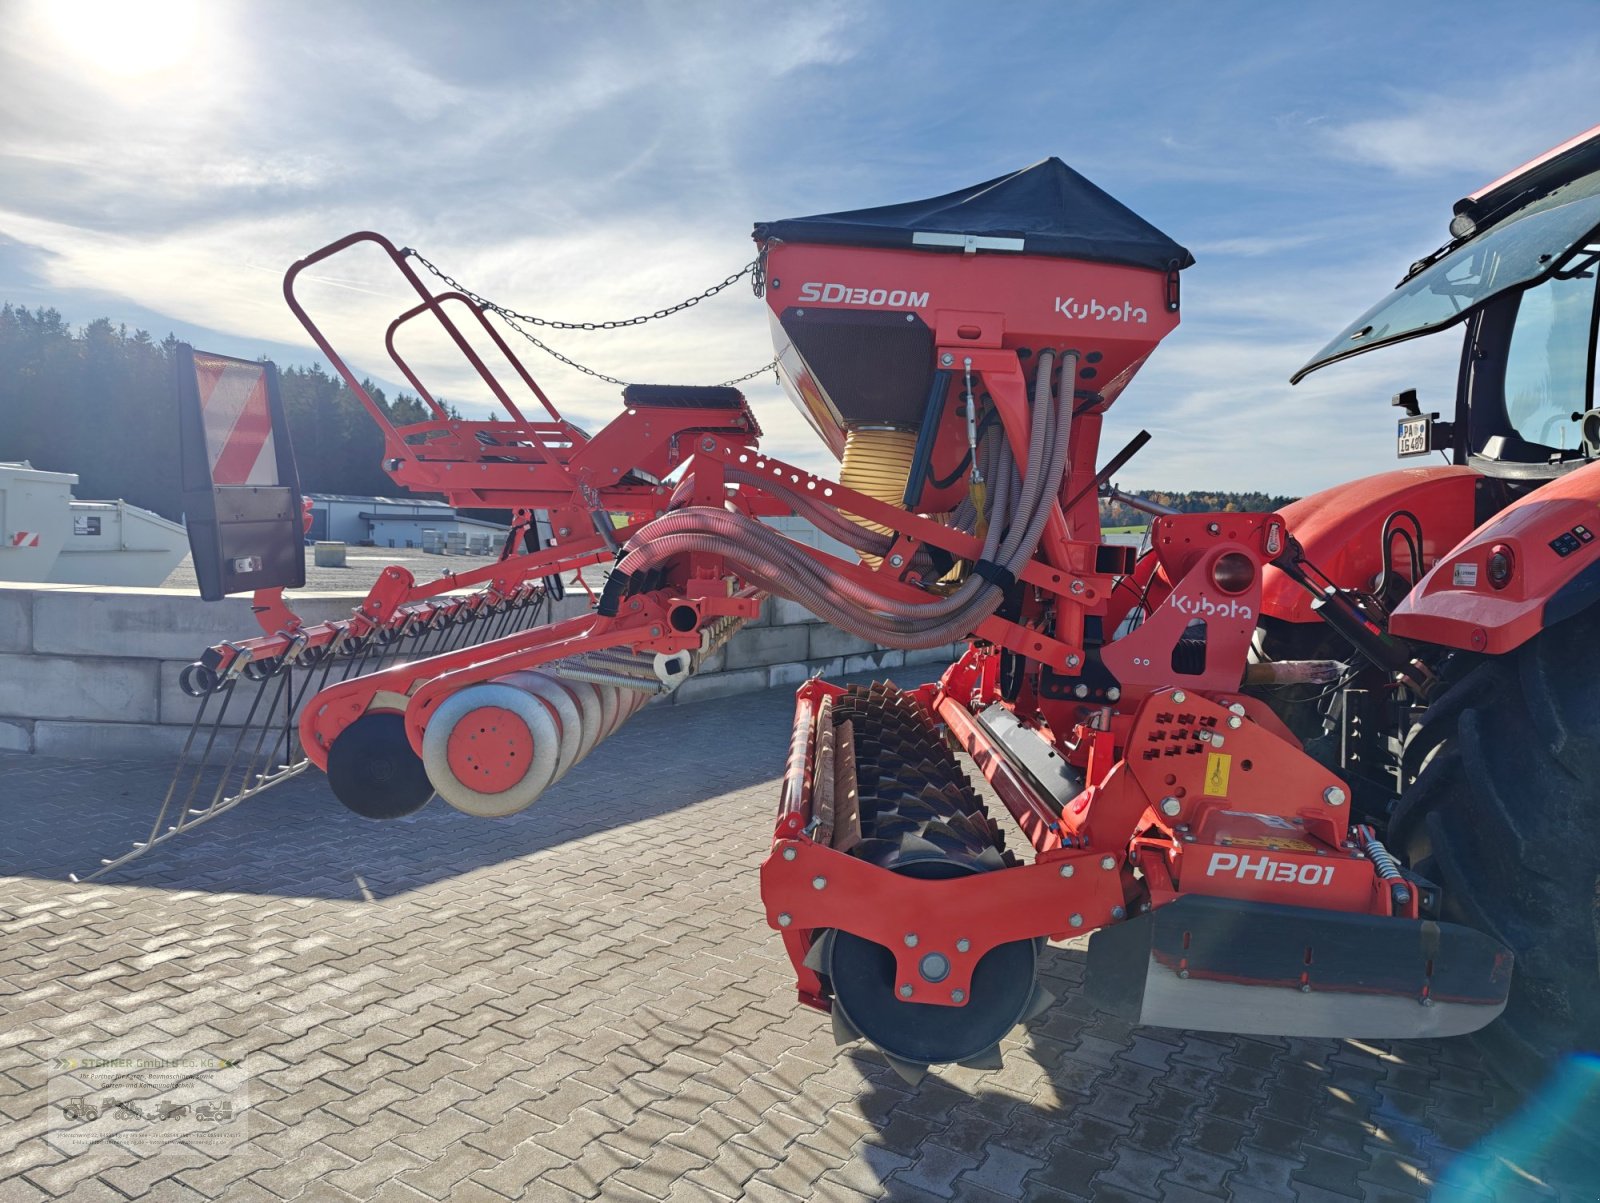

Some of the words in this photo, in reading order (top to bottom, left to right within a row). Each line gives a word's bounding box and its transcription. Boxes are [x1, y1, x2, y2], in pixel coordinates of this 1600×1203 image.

[798, 282, 929, 308] SD1300M
[1055, 296, 1148, 324] Kubota
[1403, 425, 1413, 438] PA
[1172, 593, 1253, 620] Kubota
[1206, 852, 1335, 887] PH1301
